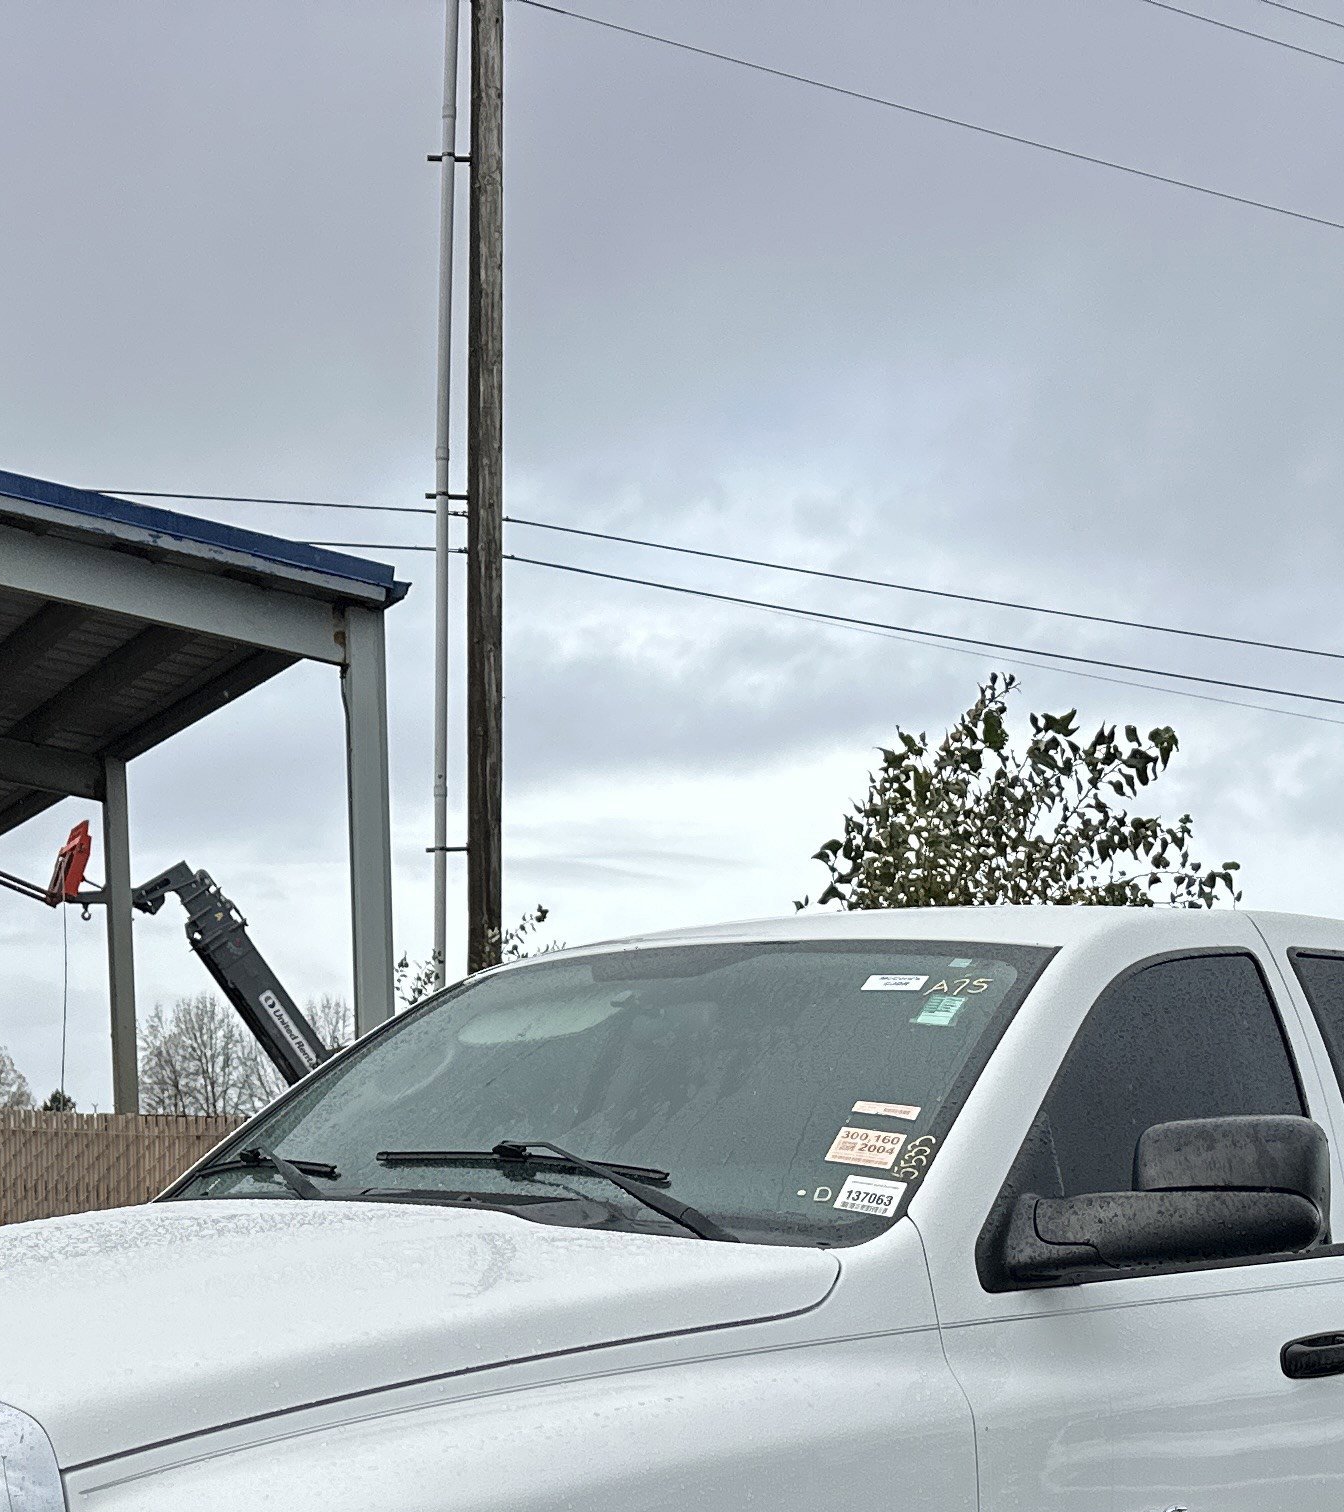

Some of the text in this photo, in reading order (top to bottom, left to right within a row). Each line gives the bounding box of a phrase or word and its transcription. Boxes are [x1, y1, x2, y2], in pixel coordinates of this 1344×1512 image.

[273, 1008, 317, 1069] United Rent
[841, 1130, 901, 1146] 300,160
[858, 1143, 896, 1156] 2004
[846, 1189, 894, 1207] 137063
